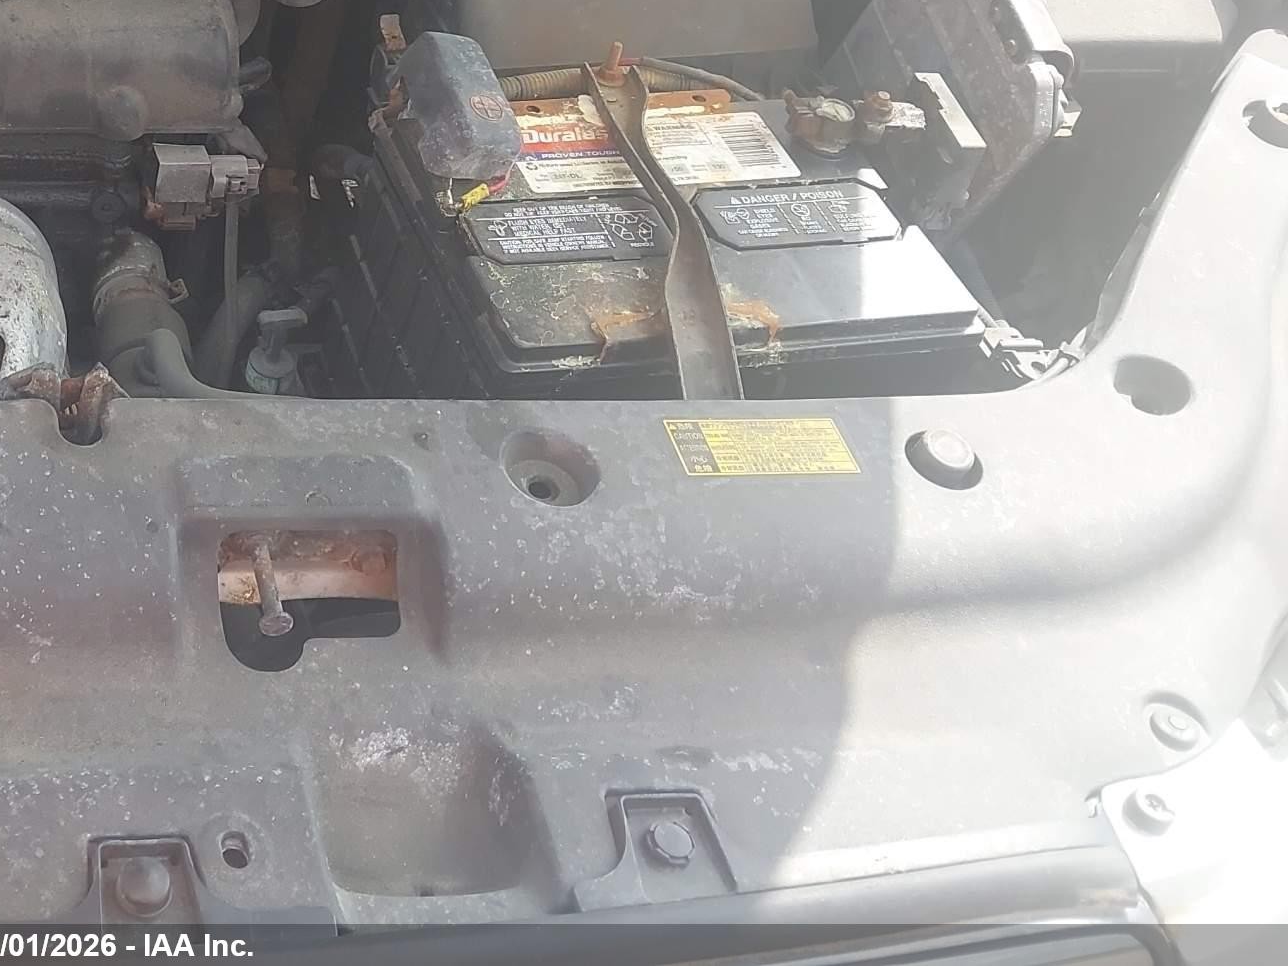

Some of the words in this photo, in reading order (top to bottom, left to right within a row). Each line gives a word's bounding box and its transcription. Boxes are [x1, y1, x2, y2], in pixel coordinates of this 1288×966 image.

[519, 125, 610, 145] Duralas
[541, 152, 584, 160] PROVEN
[741, 193, 789, 204] DANGER
[800, 189, 845, 201] POISON
